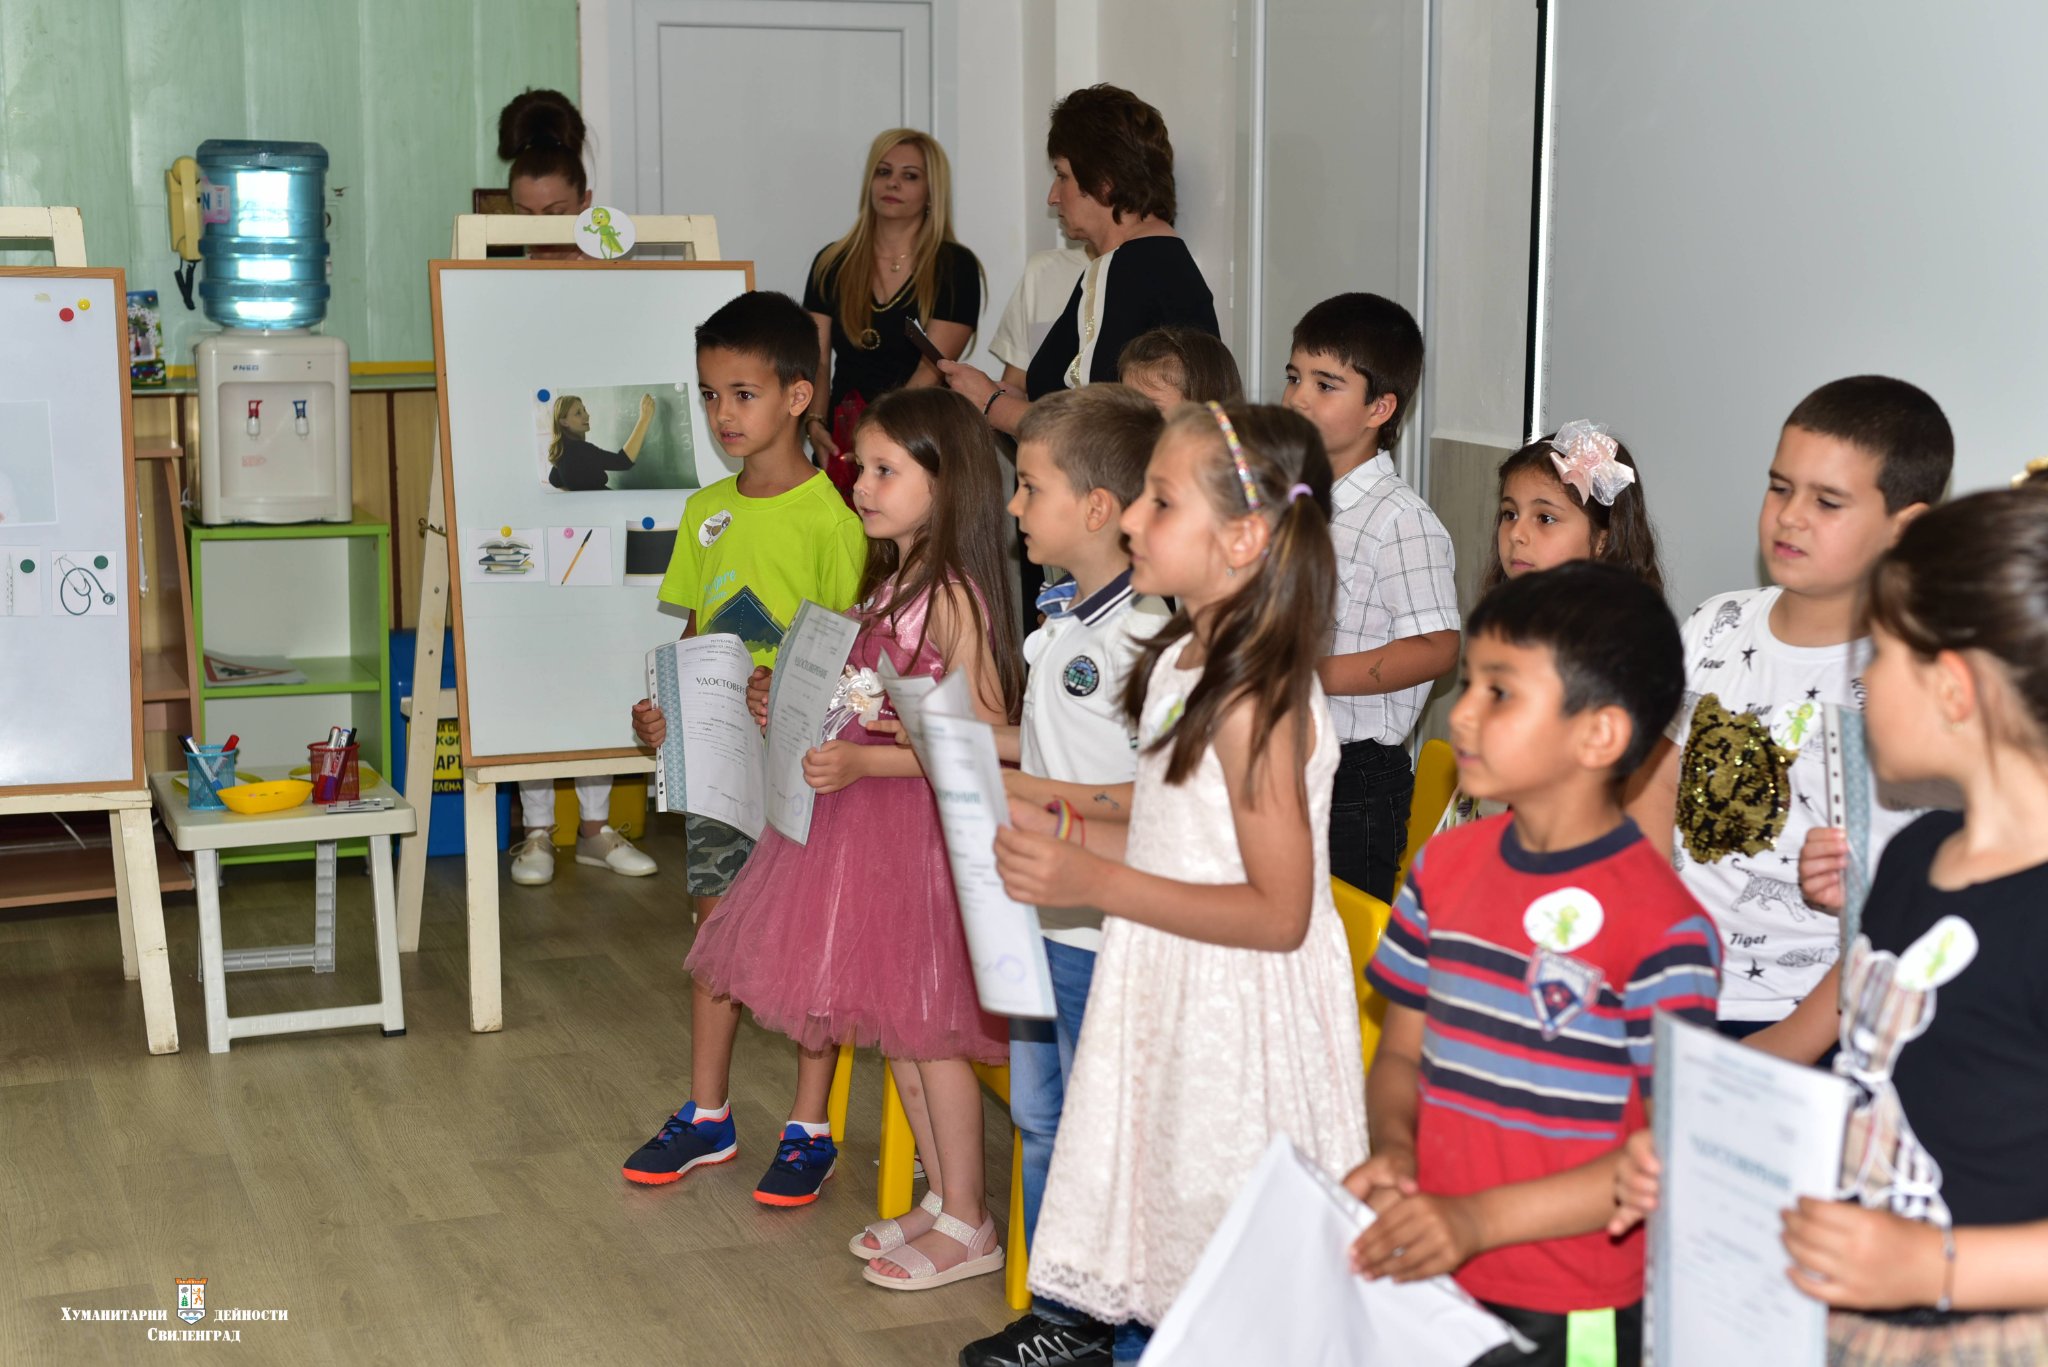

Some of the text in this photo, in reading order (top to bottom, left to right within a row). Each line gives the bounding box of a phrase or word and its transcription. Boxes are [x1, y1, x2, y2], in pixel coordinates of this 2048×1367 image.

[696, 677, 746, 696] УДОСТОВЕРЕ
[435, 755, 463, 770] АРТ
[1730, 933, 1767, 948] Tiger
